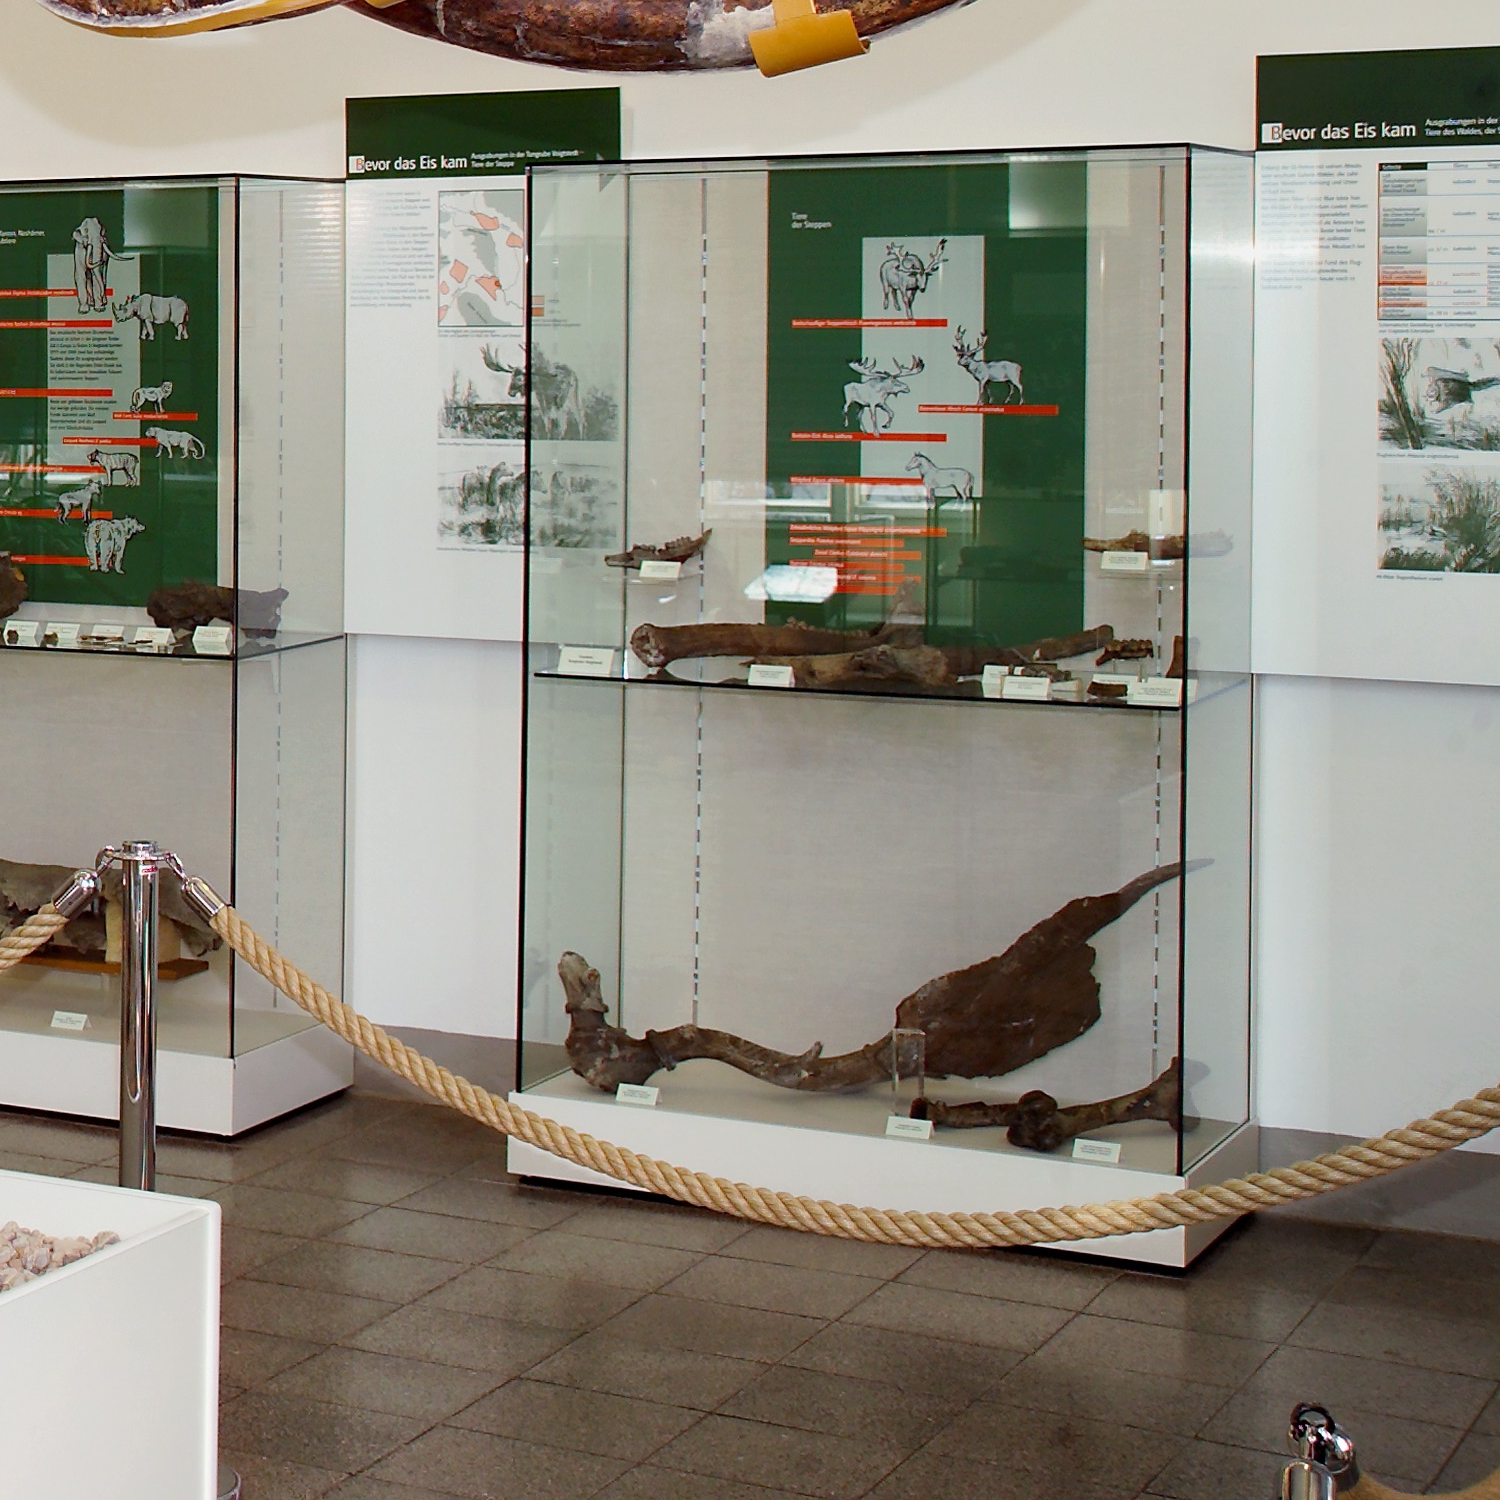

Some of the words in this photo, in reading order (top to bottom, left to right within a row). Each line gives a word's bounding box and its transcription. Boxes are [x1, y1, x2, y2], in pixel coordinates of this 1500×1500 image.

[1486, 116, 1498, 124] der
[1272, 125, 1317, 141] Bevor
[1321, 123, 1349, 140] das
[1354, 122, 1377, 139] Eis
[1381, 121, 1416, 138] kam
[355, 157, 390, 172] Bevor
[394, 156, 416, 170] das
[420, 156, 437, 169] Eis
[441, 155, 468, 169] kam
